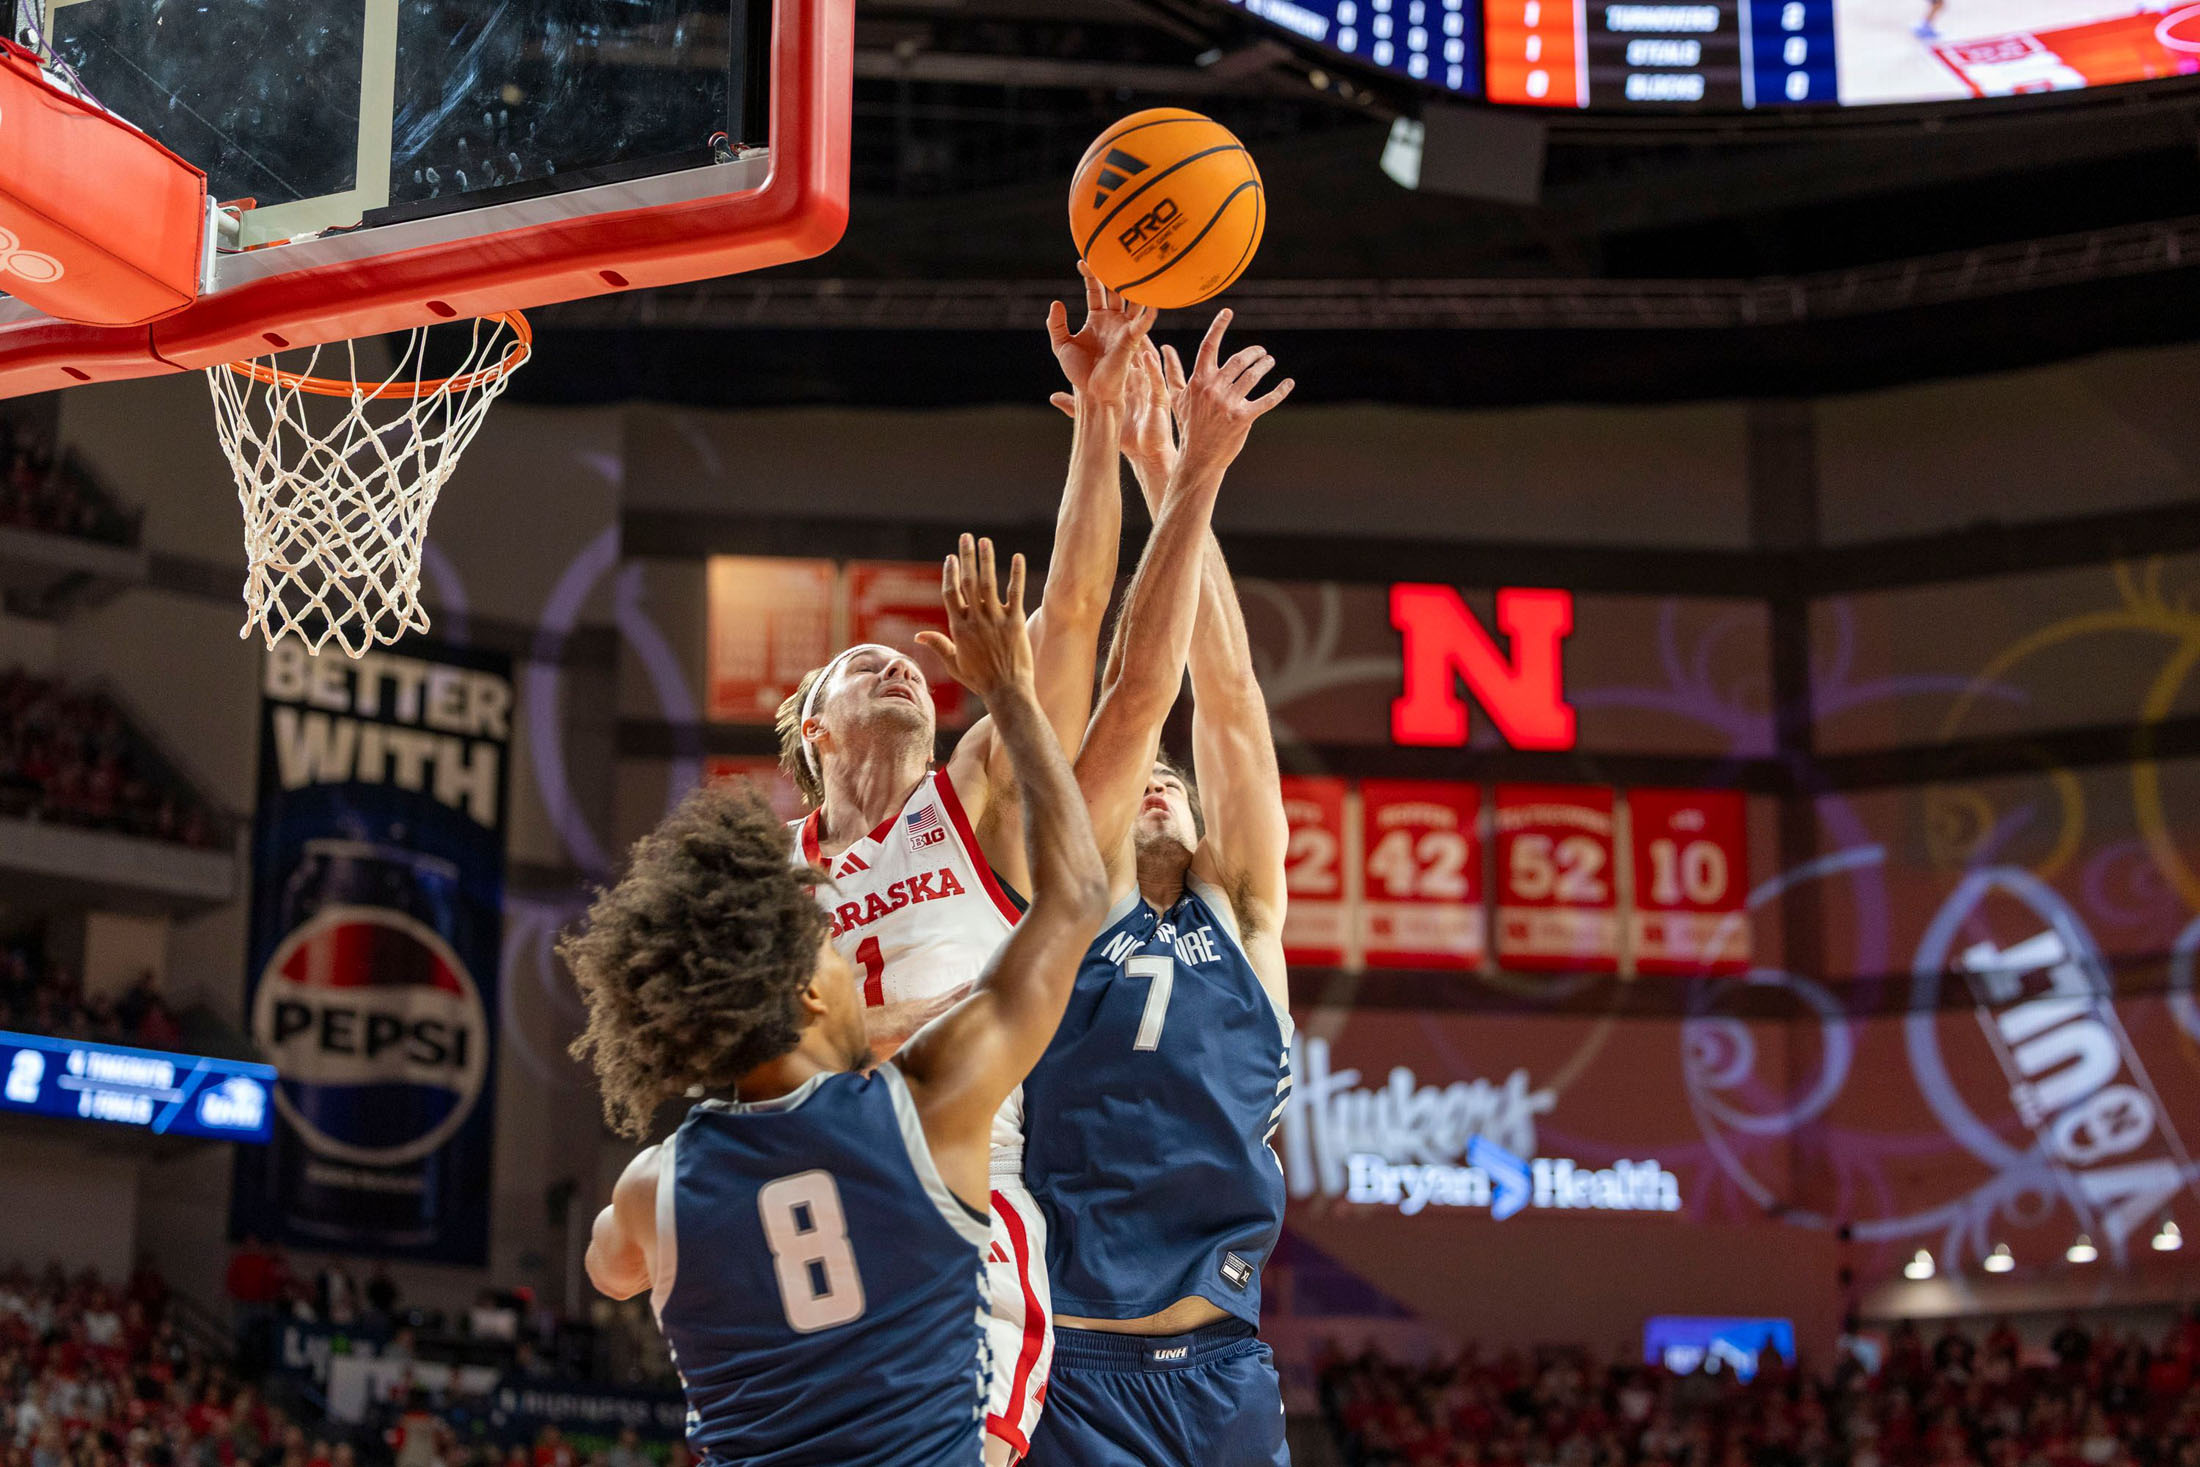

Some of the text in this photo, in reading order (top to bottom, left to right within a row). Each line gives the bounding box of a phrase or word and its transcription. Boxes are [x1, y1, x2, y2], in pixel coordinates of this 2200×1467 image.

[1119, 198, 1179, 253] PRO
[265, 636, 511, 739] BETTER
[1390, 582, 1577, 751] N
[272, 703, 499, 829] WITH
[1287, 827, 1339, 894] 2
[1368, 829, 1470, 898] 42
[1509, 833, 1609, 900] 52
[1648, 838, 1729, 905] 10
[828, 867, 966, 939] BRASKA
[856, 935, 885, 1008] 1
[1124, 954, 1175, 1051] 7
[274, 1000, 468, 1068] PEPSI
[5, 1049, 45, 1103] 2
[1347, 1153, 1682, 1216] Bryan Health
[756, 1168, 867, 1335] 8
[1154, 1346, 1188, 1360] UNH
